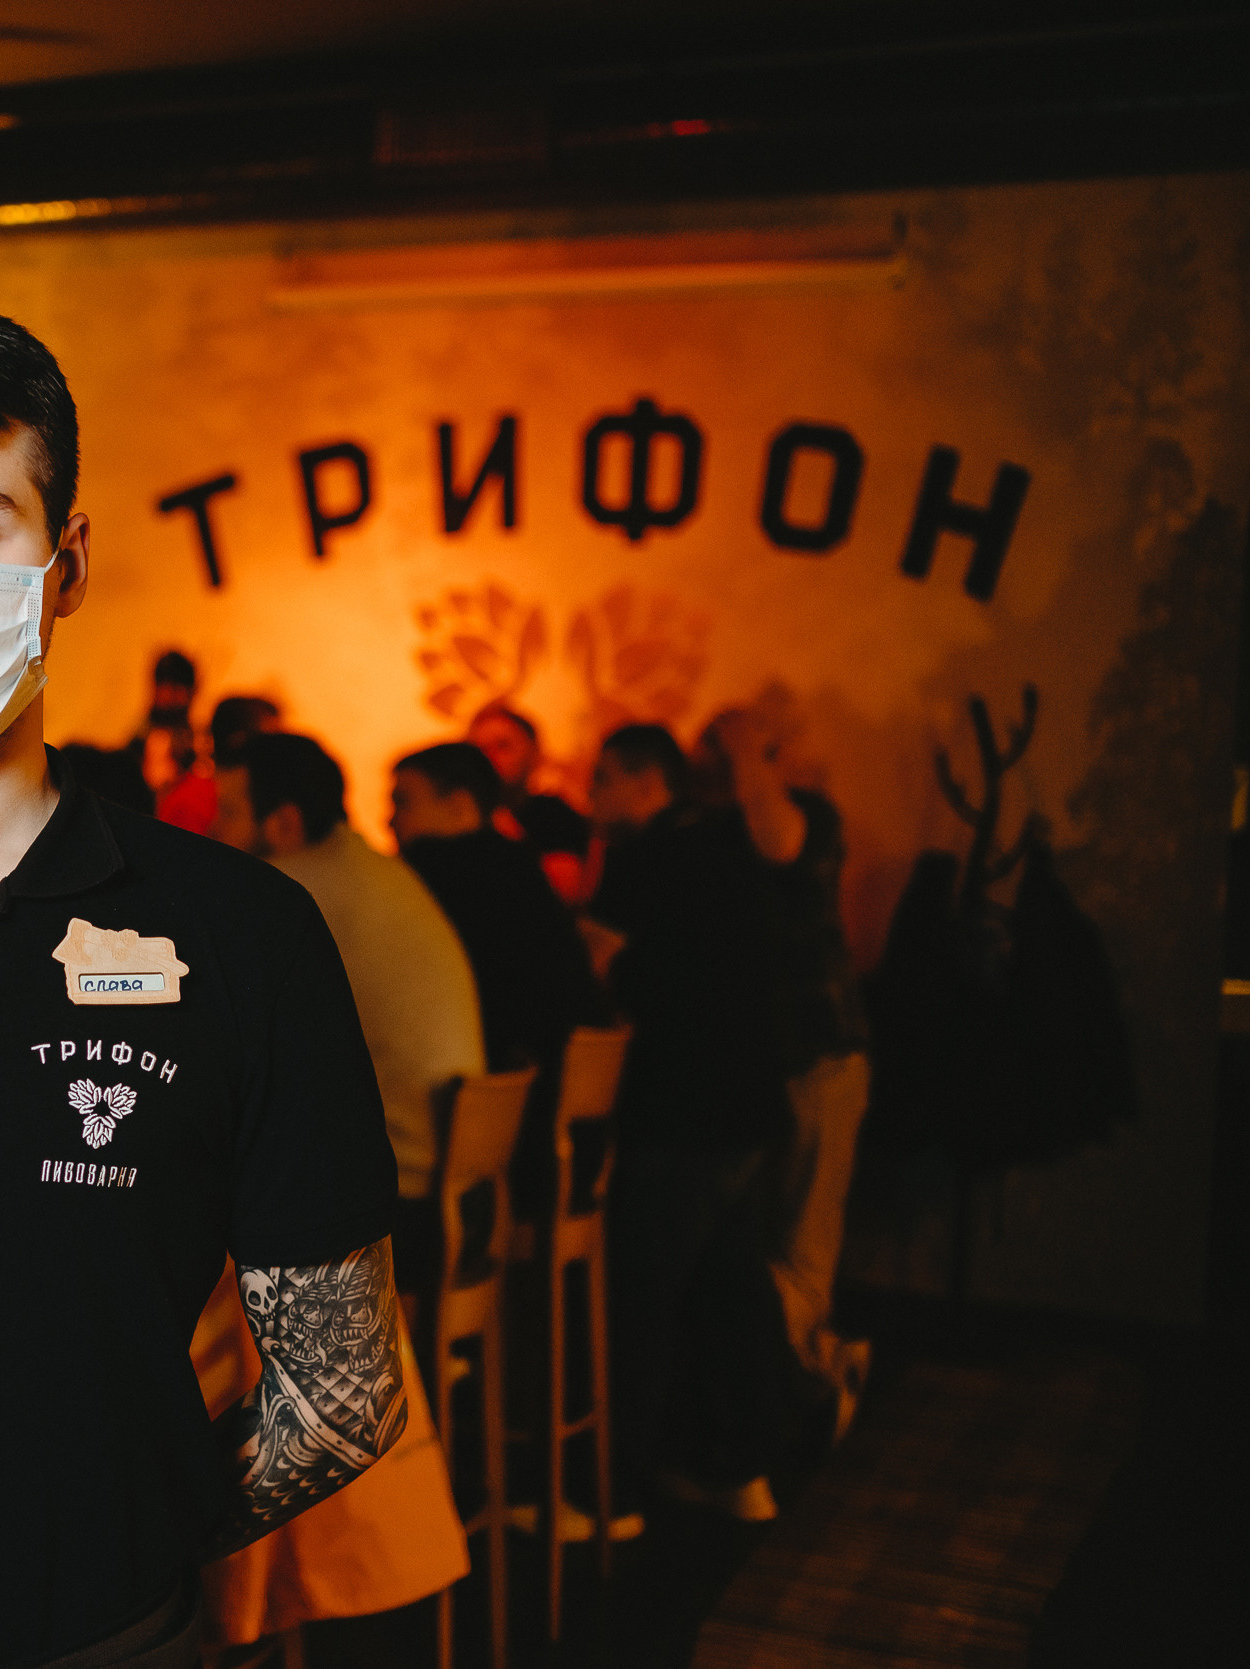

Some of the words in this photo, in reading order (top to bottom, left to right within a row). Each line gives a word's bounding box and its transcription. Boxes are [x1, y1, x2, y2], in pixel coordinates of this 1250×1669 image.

[159, 396, 1032, 602] ТРИФОН
[30, 1039, 178, 1084] ТРИФОН
[41, 1159, 137, 1188] ПИВОВАРНЯ
